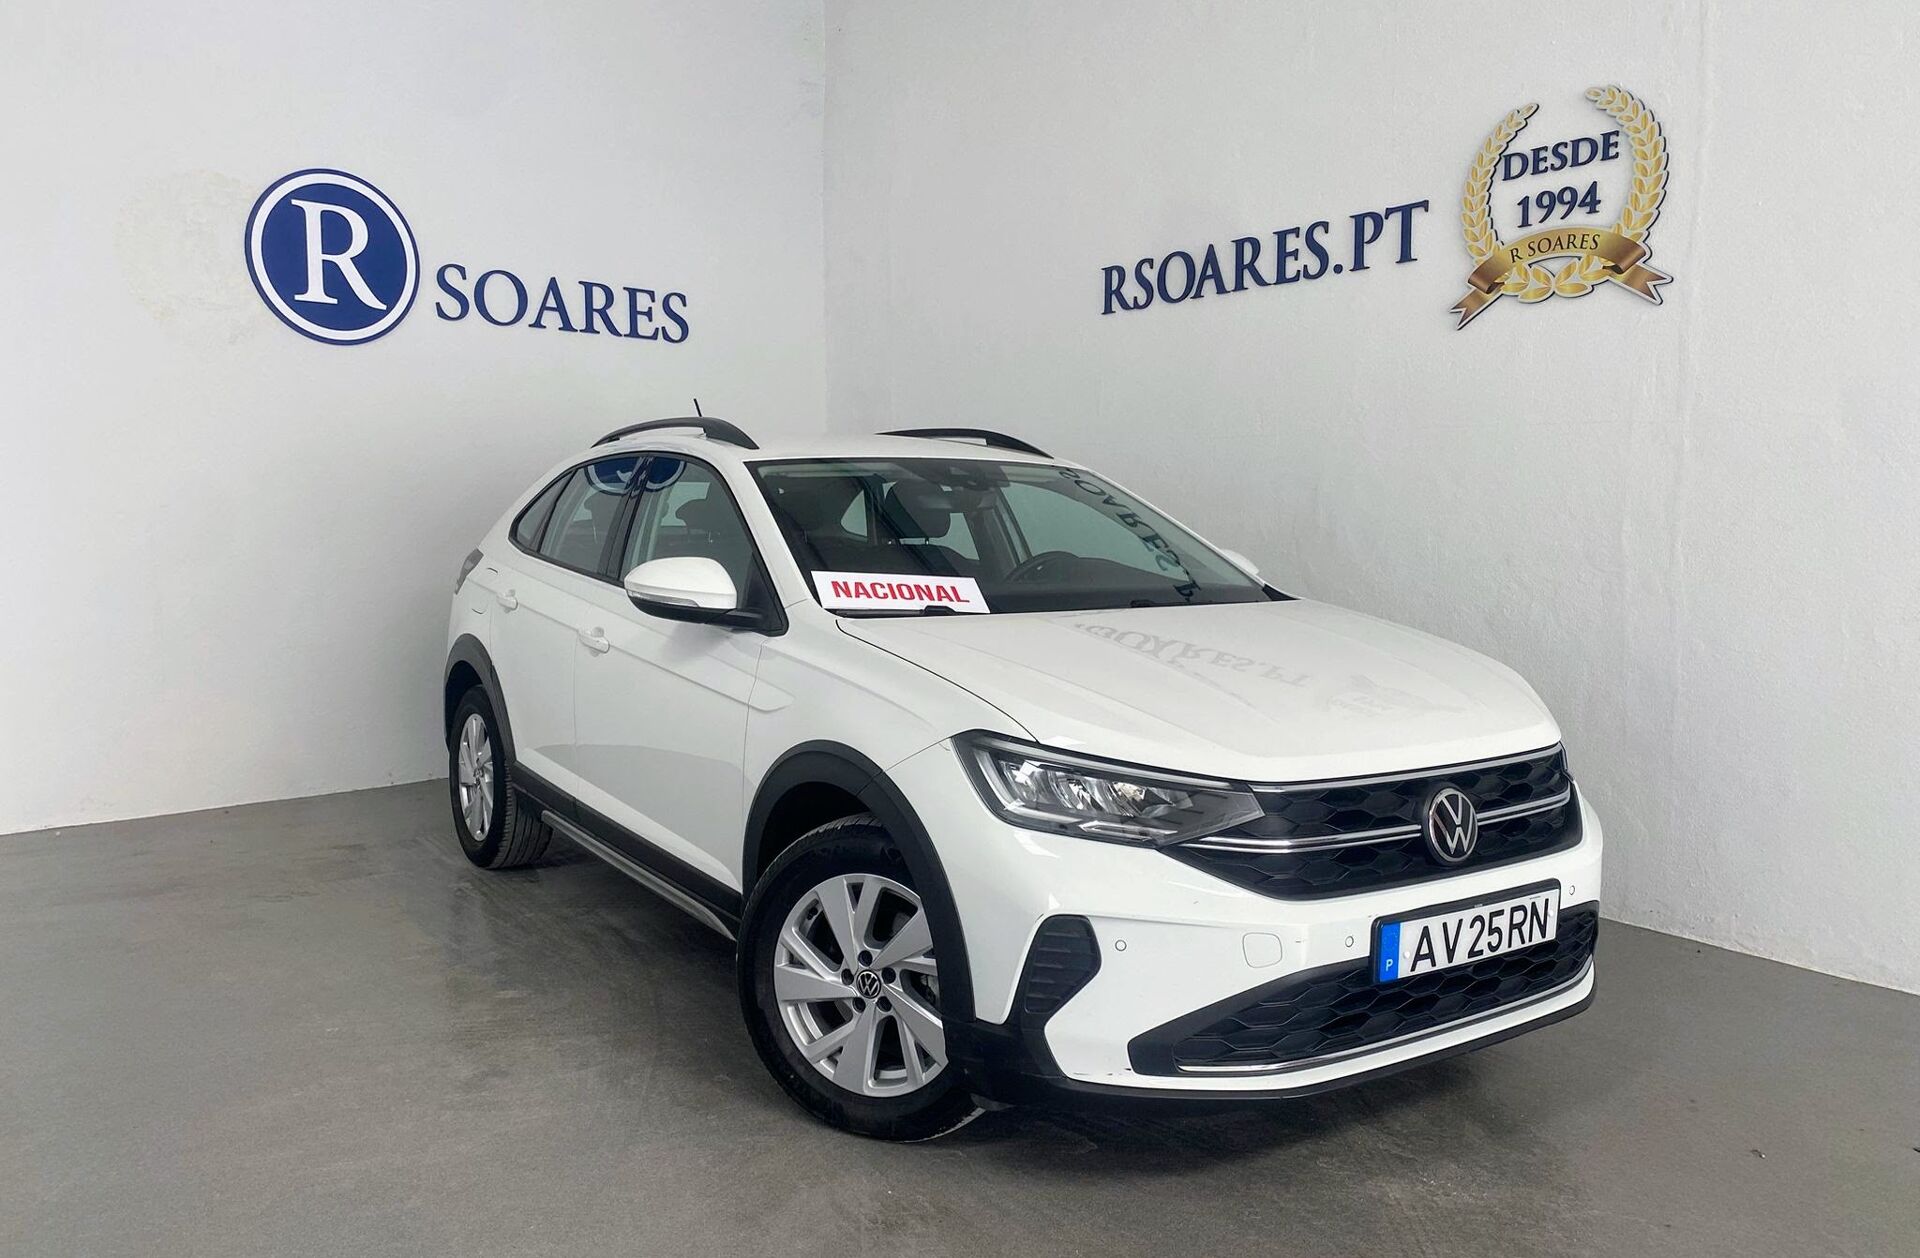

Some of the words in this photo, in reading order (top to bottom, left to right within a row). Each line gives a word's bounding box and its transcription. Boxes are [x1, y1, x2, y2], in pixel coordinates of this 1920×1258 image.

[1502, 130, 1620, 181] DESDE
[1516, 181, 1601, 228] 1994
[291, 198, 387, 310] R
[435, 263, 689, 343] SOARES
[1101, 200, 1429, 314] RSOARES.PT
[1509, 247, 1524, 263] R
[1528, 233, 1600, 257] SOARES
[831, 580, 970, 603] NACIONAL
[1385, 958, 1394, 971] P
